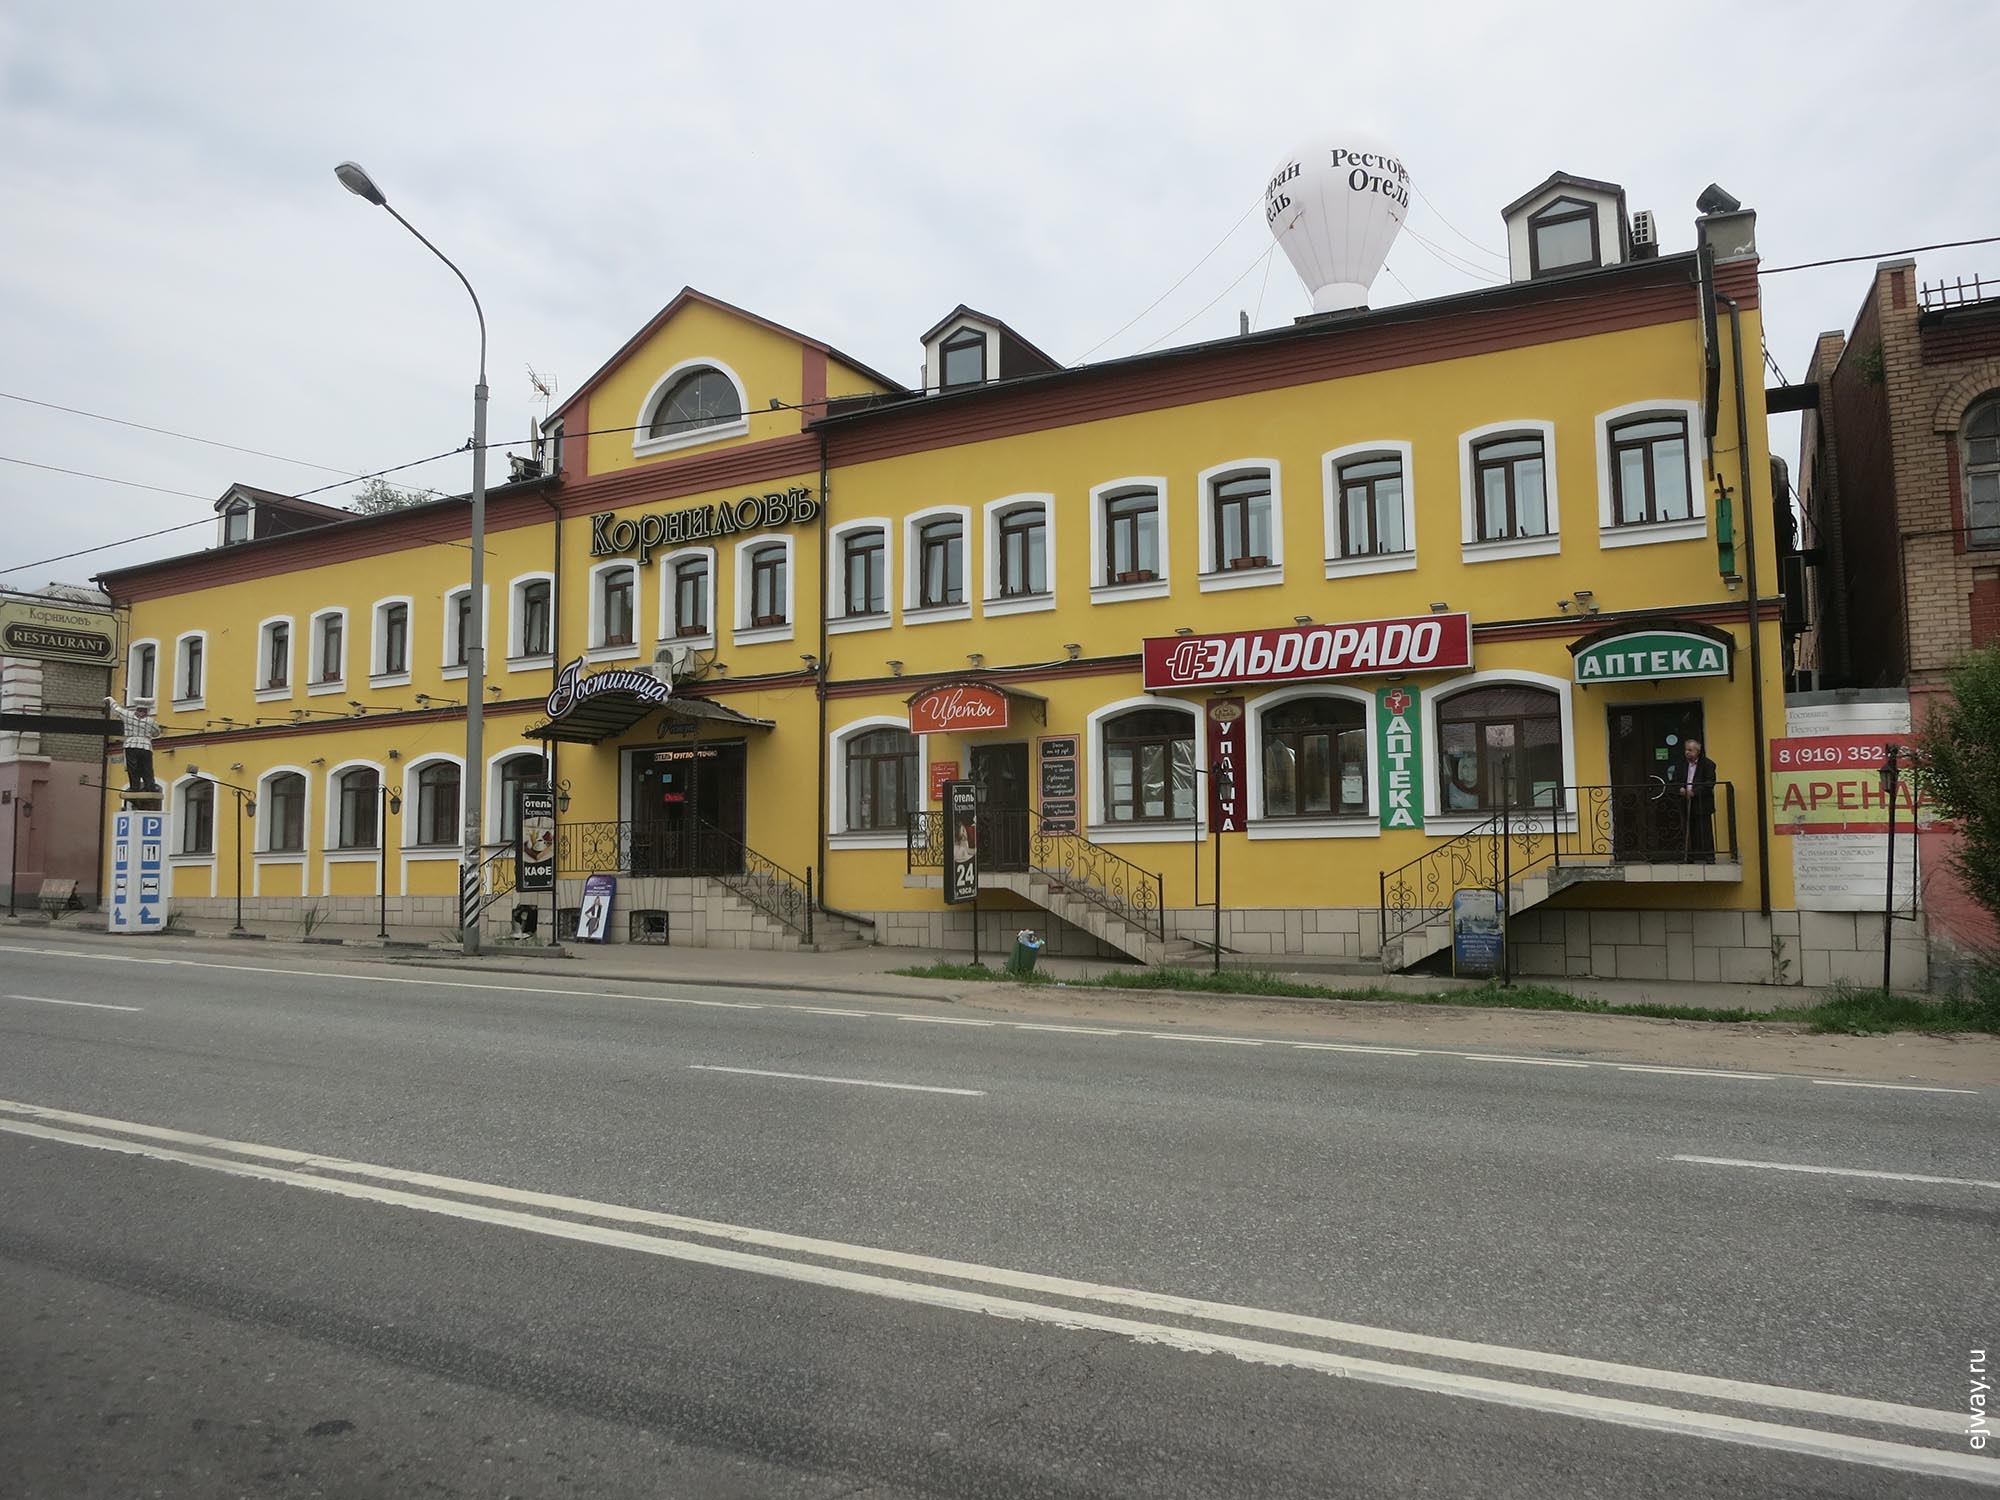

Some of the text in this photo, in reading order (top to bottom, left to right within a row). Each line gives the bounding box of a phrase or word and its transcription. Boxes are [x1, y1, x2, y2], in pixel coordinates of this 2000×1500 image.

[1348, 168, 1409, 208] Отель
[1266, 192, 1291, 223] ель
[589, 487, 821, 566] Корниловъ
[13, 630, 106, 652] RESTAURANT
[1582, 647, 1720, 677] АПТЕКА
[546, 655, 668, 718] Гостиница
[920, 687, 996, 727] Цветы
[1385, 715, 1416, 827] АПТЕКА
[1778, 749, 1791, 764] 8
[1795, 746, 1842, 765] (916)
[524, 866, 552, 876] КАФЕ
[956, 862, 975, 887] 24
